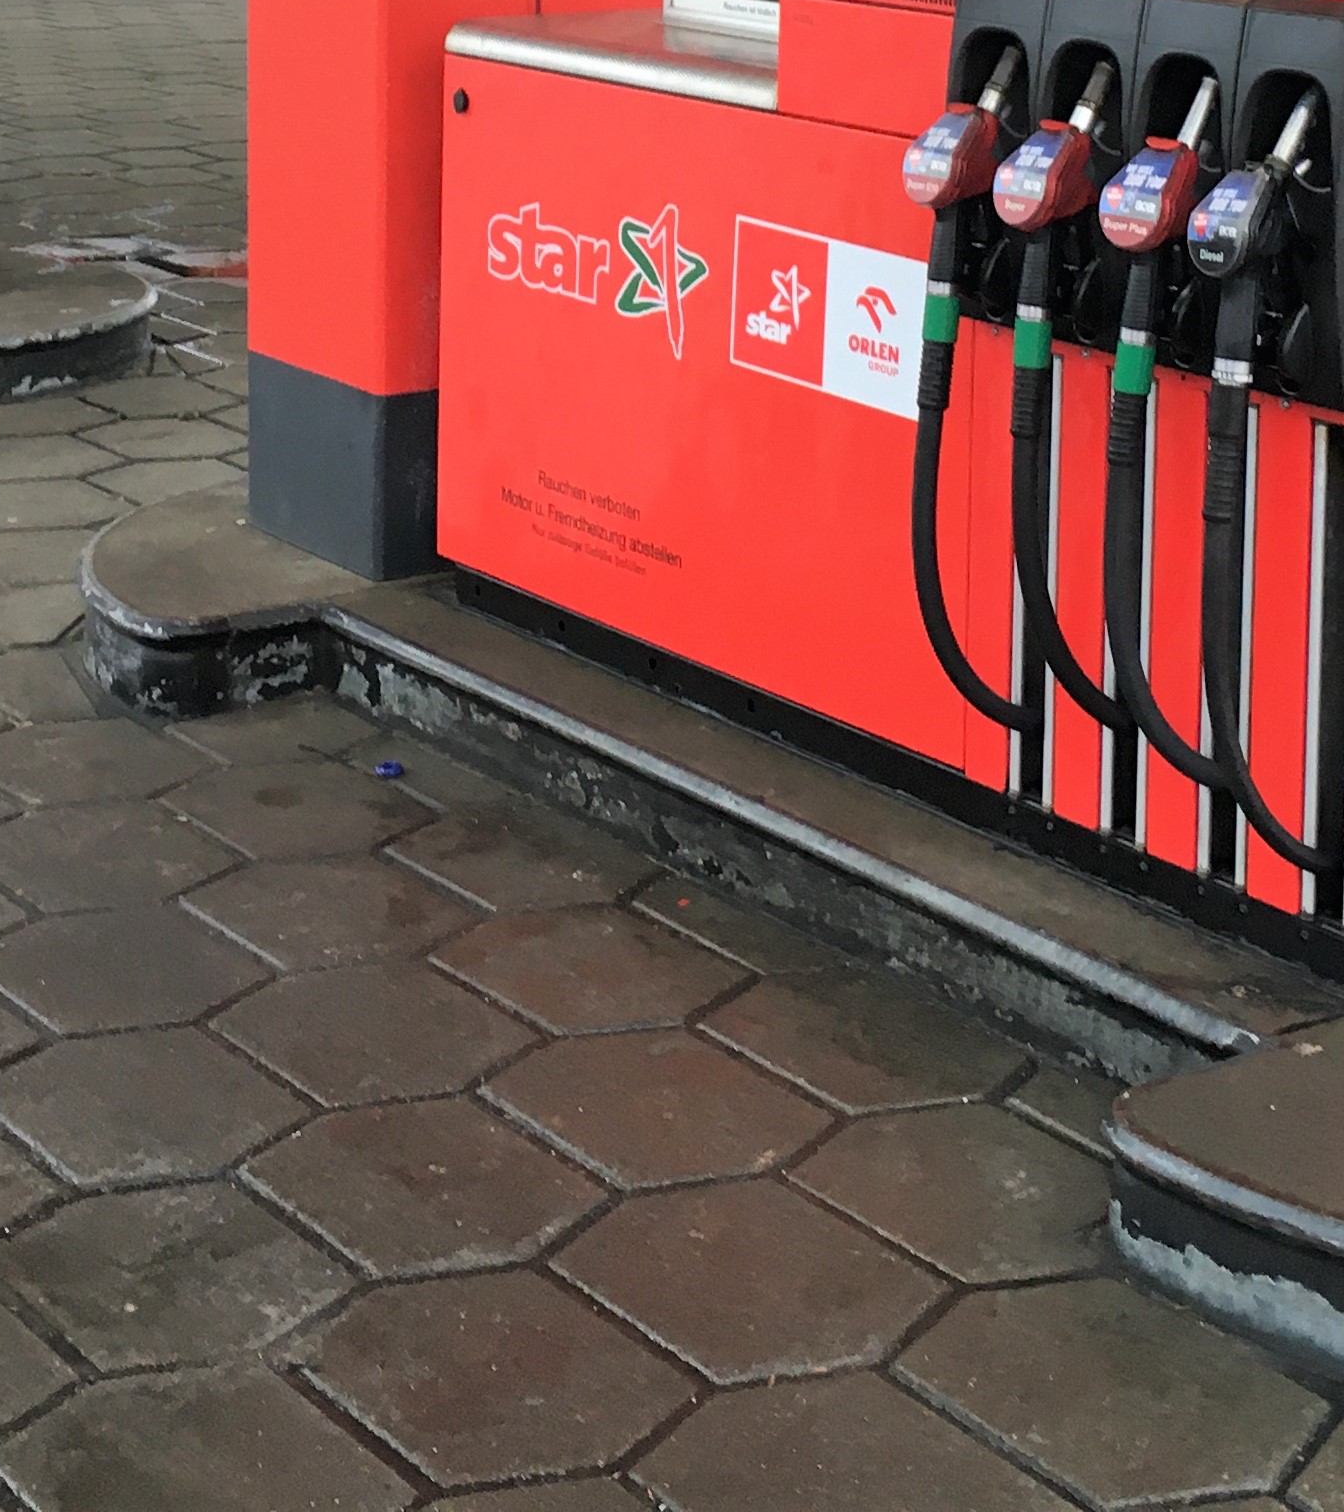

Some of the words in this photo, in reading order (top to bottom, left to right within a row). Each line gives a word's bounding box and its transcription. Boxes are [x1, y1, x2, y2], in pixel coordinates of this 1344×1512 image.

[1103, 217, 1128, 232] Super
[1128, 222, 1148, 237] Plus
[487, 201, 610, 305] star
[1199, 248, 1224, 263] Diesel
[745, 310, 792, 345] star
[848, 334, 899, 365] ORLEN
[868, 360, 899, 377] GROUP
[538, 469, 587, 501] Rauchen
[590, 492, 641, 521] verboten
[501, 486, 532, 512] Motor
[548, 503, 627, 552] Fremdheizung
[629, 536, 683, 569] abstellen
